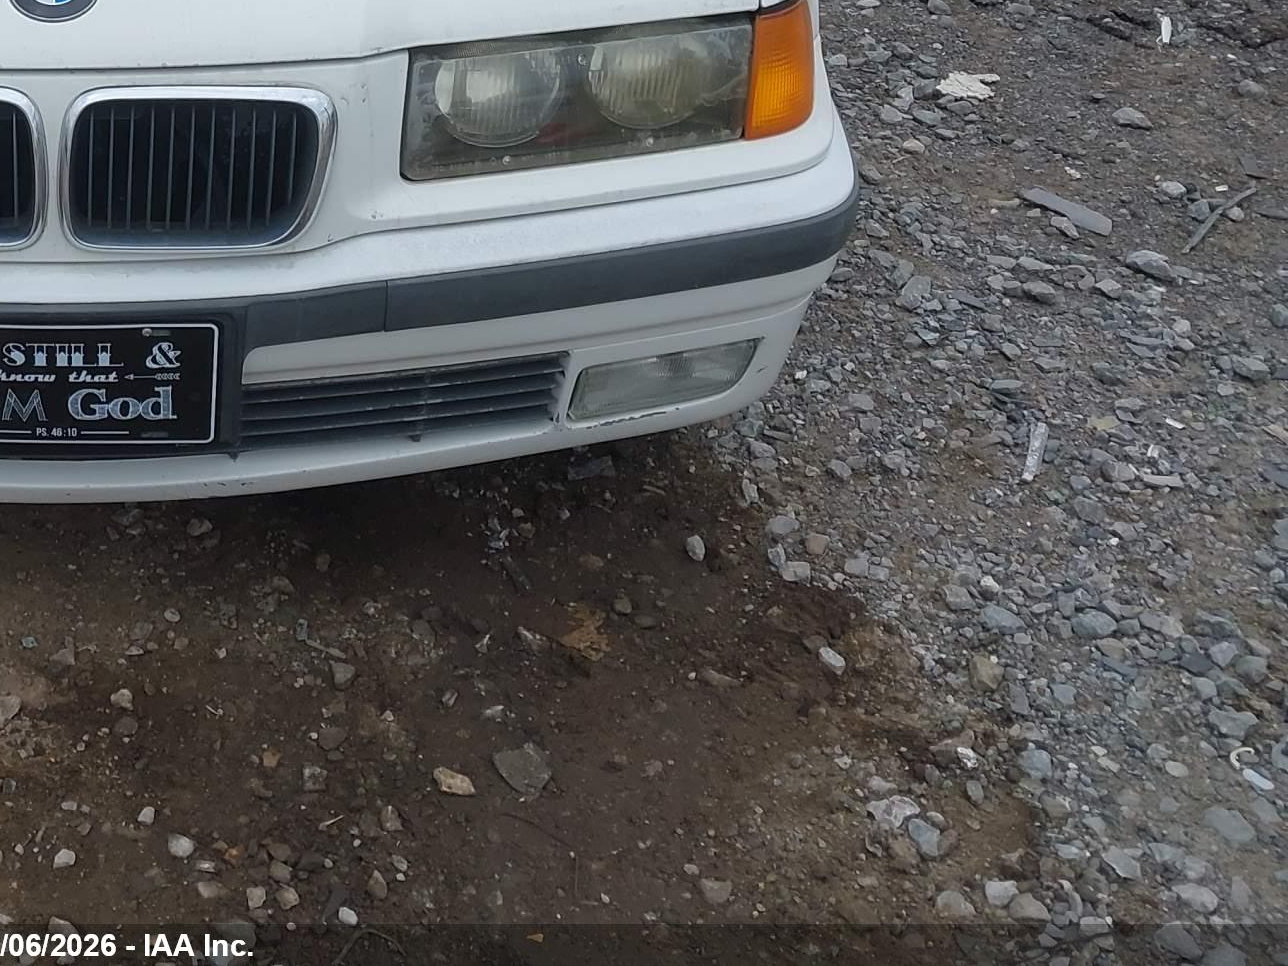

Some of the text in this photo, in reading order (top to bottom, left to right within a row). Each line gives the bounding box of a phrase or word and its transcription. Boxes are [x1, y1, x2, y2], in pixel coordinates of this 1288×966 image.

[2, 342, 124, 367] STILL
[145, 342, 182, 369] &
[68, 370, 119, 383] that
[67, 384, 178, 421] God
